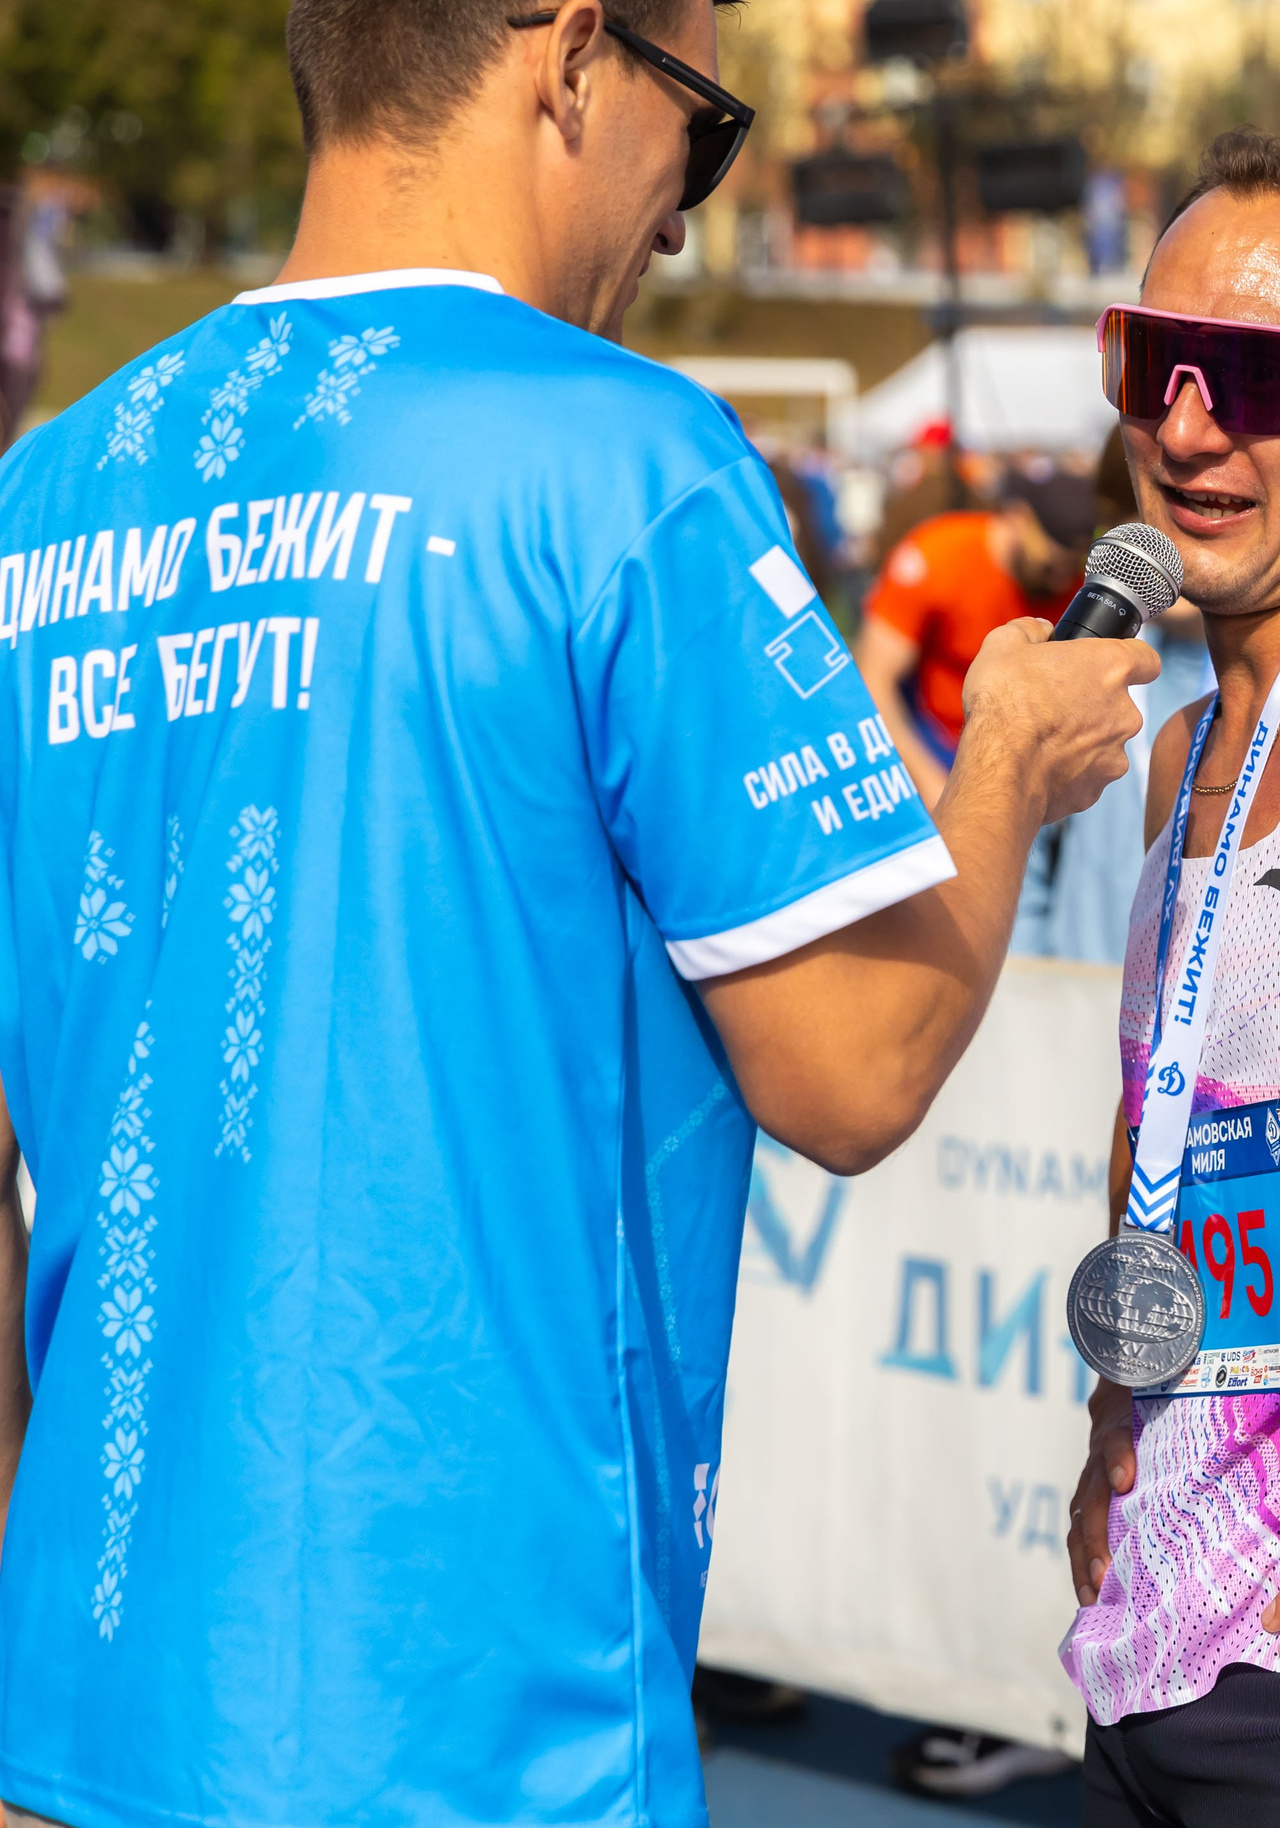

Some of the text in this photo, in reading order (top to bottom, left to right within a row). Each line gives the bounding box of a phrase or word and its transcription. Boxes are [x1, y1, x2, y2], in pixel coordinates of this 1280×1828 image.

[0, 491, 456, 650] ДИНАМО БЕЖИТ -
[1087, 592, 1104, 602] BETA
[48, 617, 320, 745] ВСЕ БЕГУТ!
[743, 744, 830, 810] СИЛА
[826, 731, 857, 770] В
[811, 794, 843, 836] И
[1174, 720, 1269, 1026] ДИНАМО БЕЖИТ!
[1186, 1116, 1252, 1148] АМОВСКАЯ
[938, 1135, 1108, 1205] DYNAM
[1191, 1149, 1225, 1175] МИЛЯ
[1226, 1351, 1241, 1362] UDS
[1227, 1376, 1248, 1388] Effort
